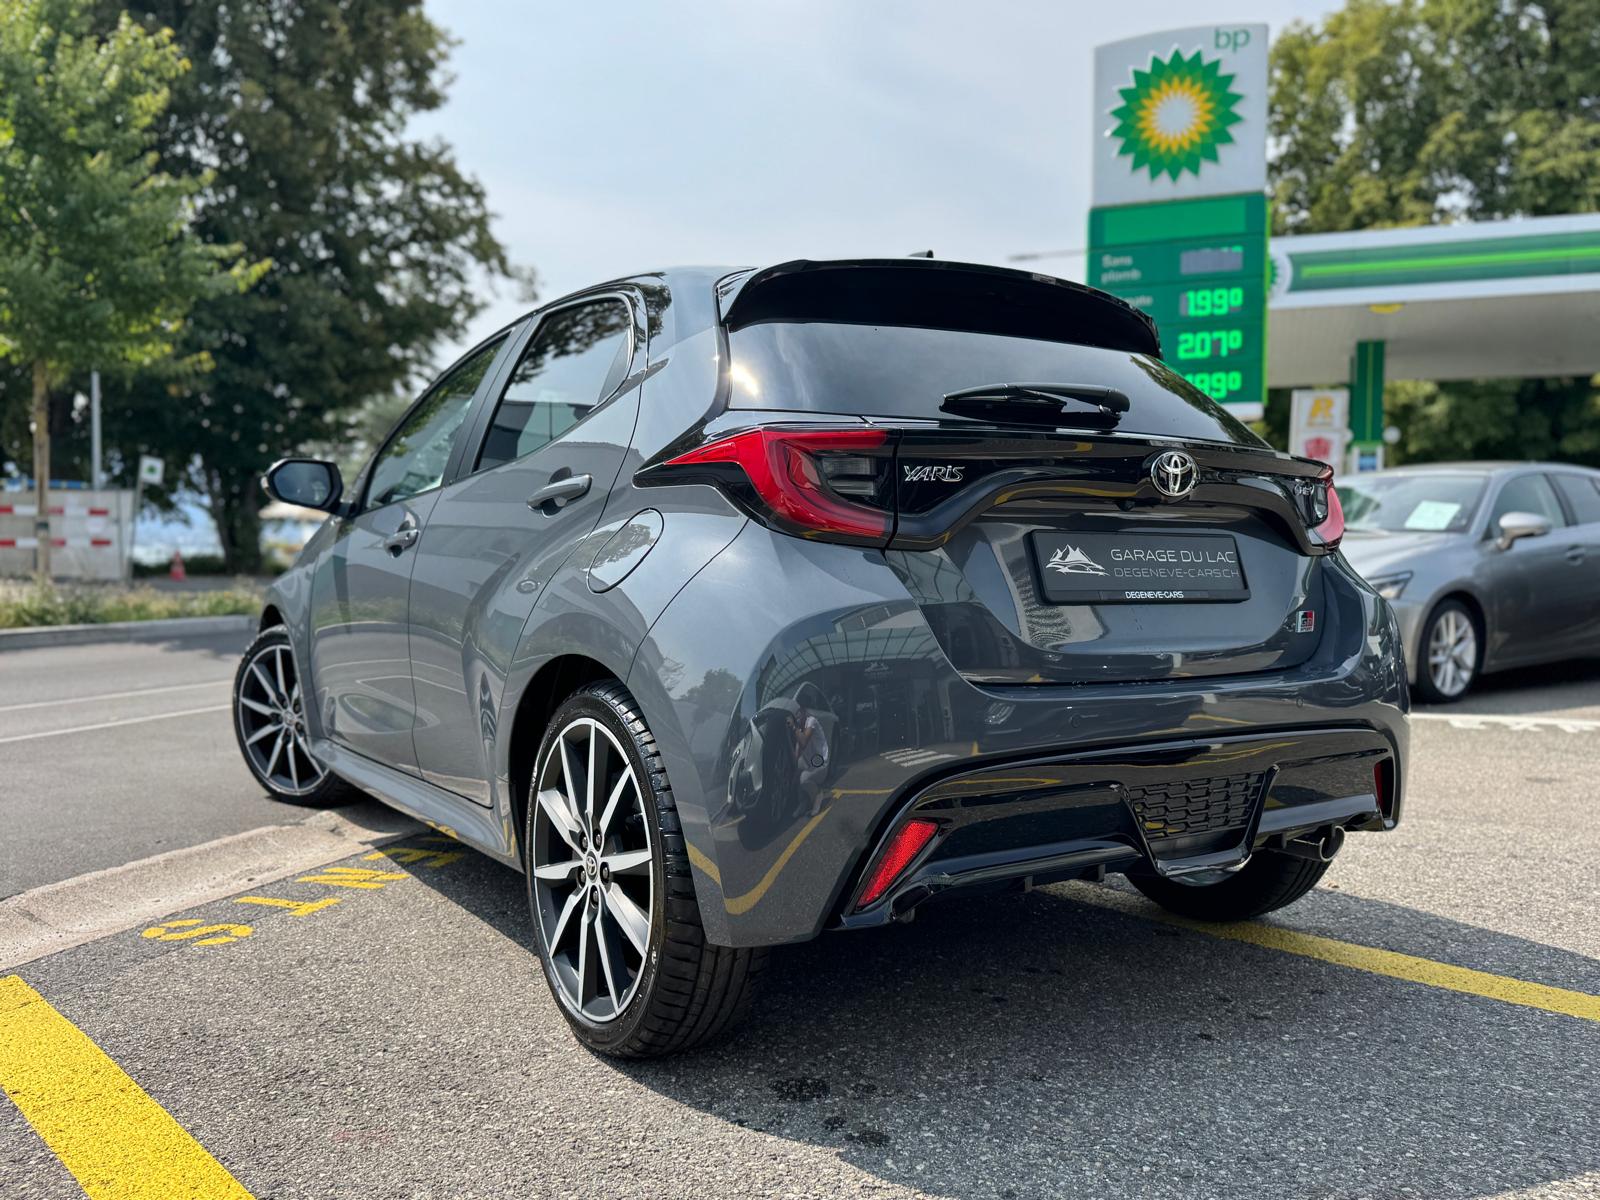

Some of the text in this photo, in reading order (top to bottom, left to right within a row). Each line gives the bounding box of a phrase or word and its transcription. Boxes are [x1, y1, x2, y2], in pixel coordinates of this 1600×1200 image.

[1214, 28, 1250, 52] bp
[903, 465, 965, 482] YARIS
[1110, 549, 1236, 563] GARAGE DU LAC
[1125, 591, 1184, 599] DEGENEVE-CARS
